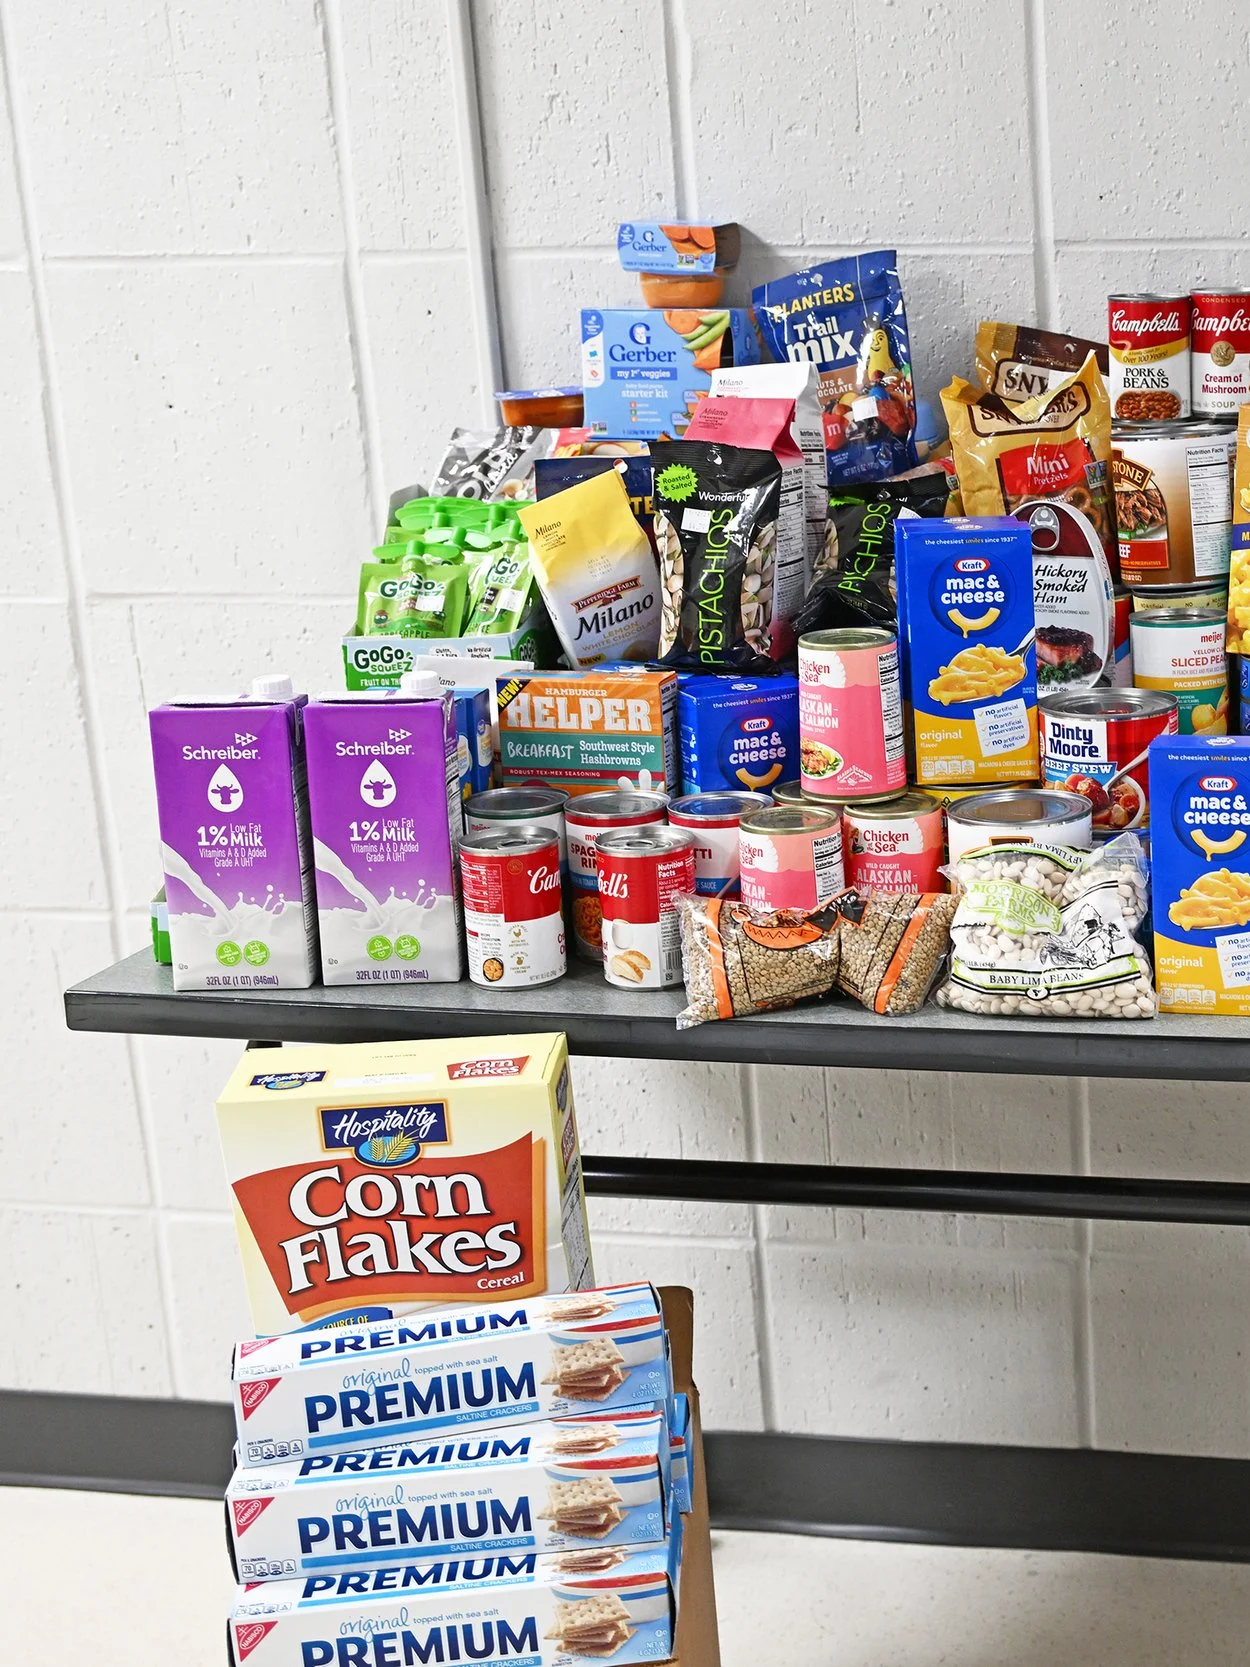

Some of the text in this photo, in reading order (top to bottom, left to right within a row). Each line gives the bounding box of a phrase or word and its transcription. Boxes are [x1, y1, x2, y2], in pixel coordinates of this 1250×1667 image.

[632, 241, 668, 254] Gerber
[772, 281, 855, 322] PLANTERS
[792, 315, 838, 337] Trail
[1111, 309, 1183, 336] Campbell's
[608, 343, 678, 363] Gerber
[785, 332, 857, 365] mix
[1126, 366, 1167, 378] PORK &
[1205, 373, 1233, 384] Cream
[1122, 377, 1170, 389] BEANS
[1202, 383, 1248, 396] Mushroom
[622, 386, 669, 399] starter kit
[1026, 452, 1070, 475] Mini
[961, 560, 984, 571] Kraft
[1034, 563, 1088, 583] Hickory
[699, 506, 734, 665] PISTACHIOS
[946, 573, 1001, 590] mac &
[1033, 577, 1088, 594] Smoked
[577, 580, 637, 610] PEPPERIDGE FARM
[1033, 590, 1068, 605] Ham
[545, 687, 608, 697] HAMBURGER
[507, 692, 653, 732] HELPER
[1050, 720, 1095, 749] Dinty
[335, 741, 416, 758] Schreiber
[507, 741, 575, 761] BREAKFAST
[580, 740, 655, 754] Southwest Style
[1048, 737, 1099, 760] Moore
[580, 753, 641, 766] Hashbrowns
[1044, 759, 1113, 776] BEEF STEW
[382, 817, 415, 830] Low Fat
[382, 826, 417, 842] Milk
[863, 829, 911, 843] Chicken
[856, 869, 913, 884] ALASKAN
[331, 1106, 439, 1145] Hospitality
[288, 1164, 492, 1228] Corn
[278, 1218, 523, 1296] Flakes
[342, 1354, 499, 1397] original topped with sea salt
[304, 1361, 537, 1434] PREMIUM
[455, 1403, 533, 1424] SALTINE CRACKERS
